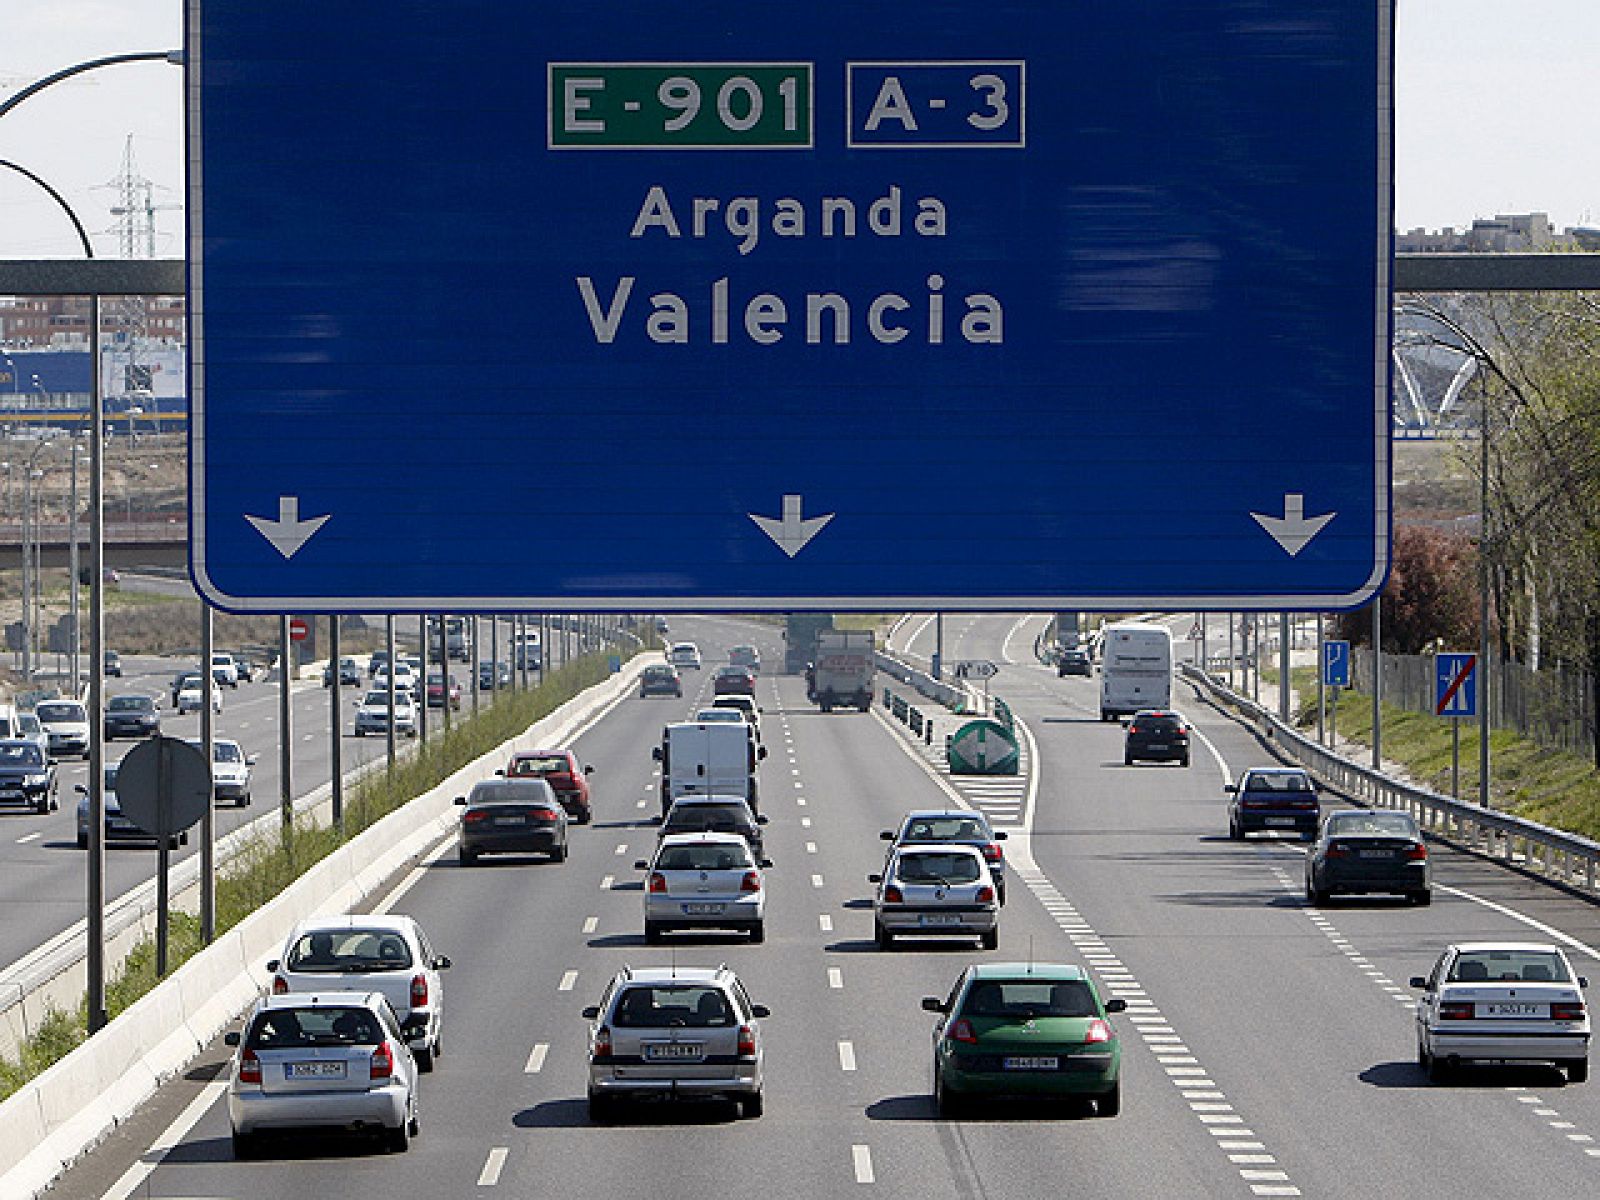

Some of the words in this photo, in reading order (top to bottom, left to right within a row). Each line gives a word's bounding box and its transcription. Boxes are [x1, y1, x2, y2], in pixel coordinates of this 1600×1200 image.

[562, 77, 798, 133] E-901
[863, 74, 1010, 132] A-3
[629, 185, 949, 256] Arganda
[575, 273, 1006, 345] Valencia
